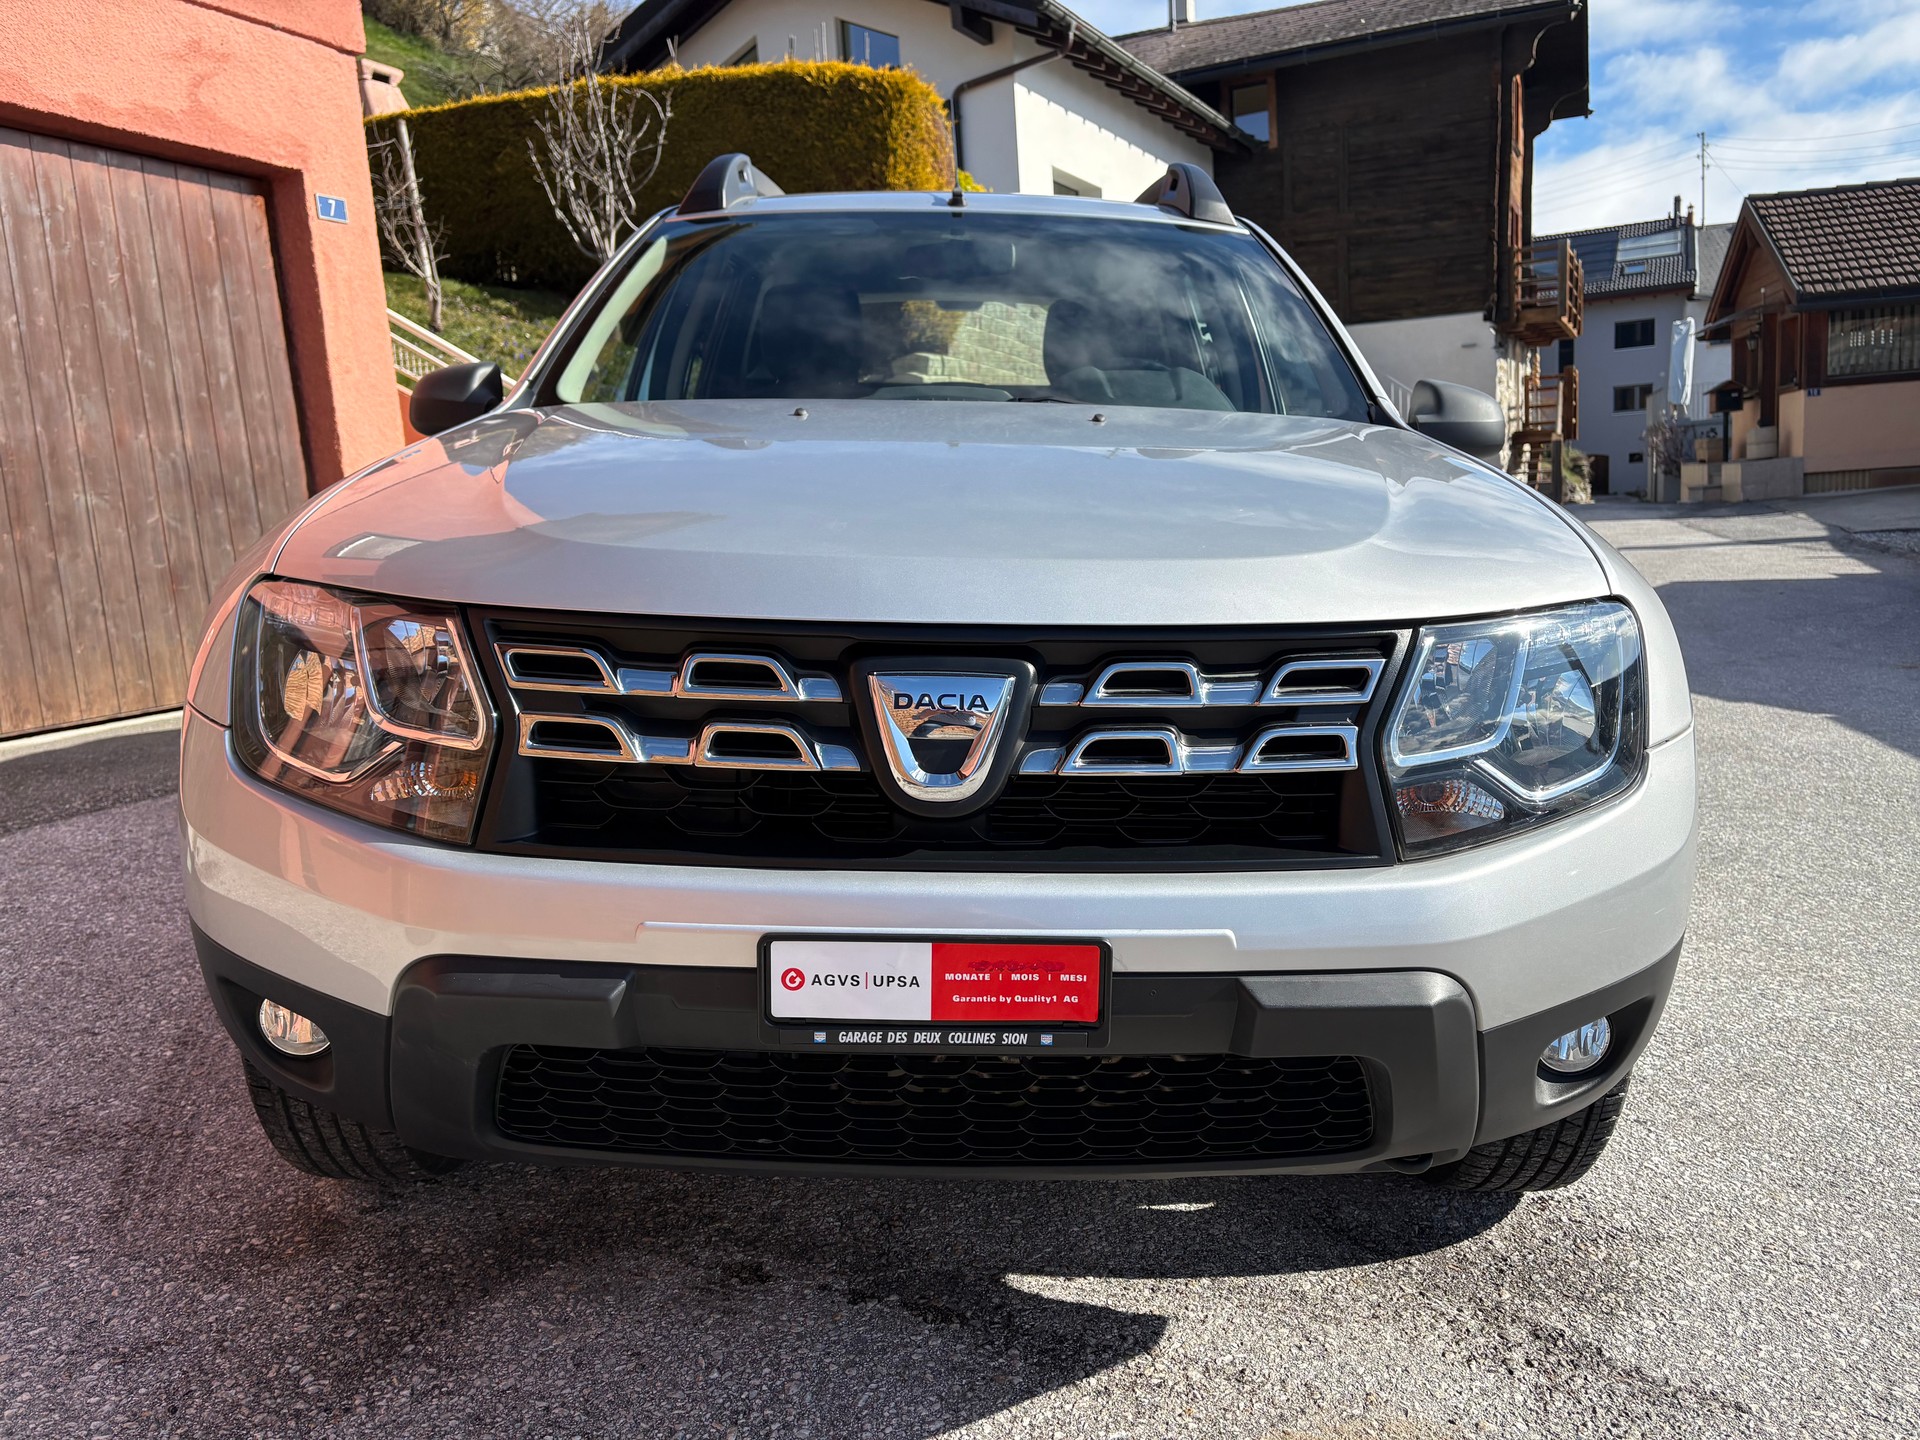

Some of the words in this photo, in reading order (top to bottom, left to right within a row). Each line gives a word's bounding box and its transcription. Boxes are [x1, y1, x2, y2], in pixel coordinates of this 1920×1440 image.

[327, 199, 336, 217] 7
[893, 693, 989, 711] DACIA
[811, 974, 861, 987] AGVS
[873, 975, 921, 988] UPSA
[944, 973, 991, 982] MONATE
[1011, 973, 1040, 982] MOIS
[1059, 974, 1087, 983] MESI
[952, 994, 997, 1003] Garantie
[999, 994, 1012, 1004] by
[1014, 994, 1058, 1004] Quality1
[1063, 995, 1079, 1003] AG
[838, 1031, 883, 1044] GARAGE
[887, 1032, 908, 1044] DES
[913, 1032, 942, 1044] DEUX
[948, 1032, 996, 1045] COLLINES
[1001, 1033, 1028, 1045] SION
